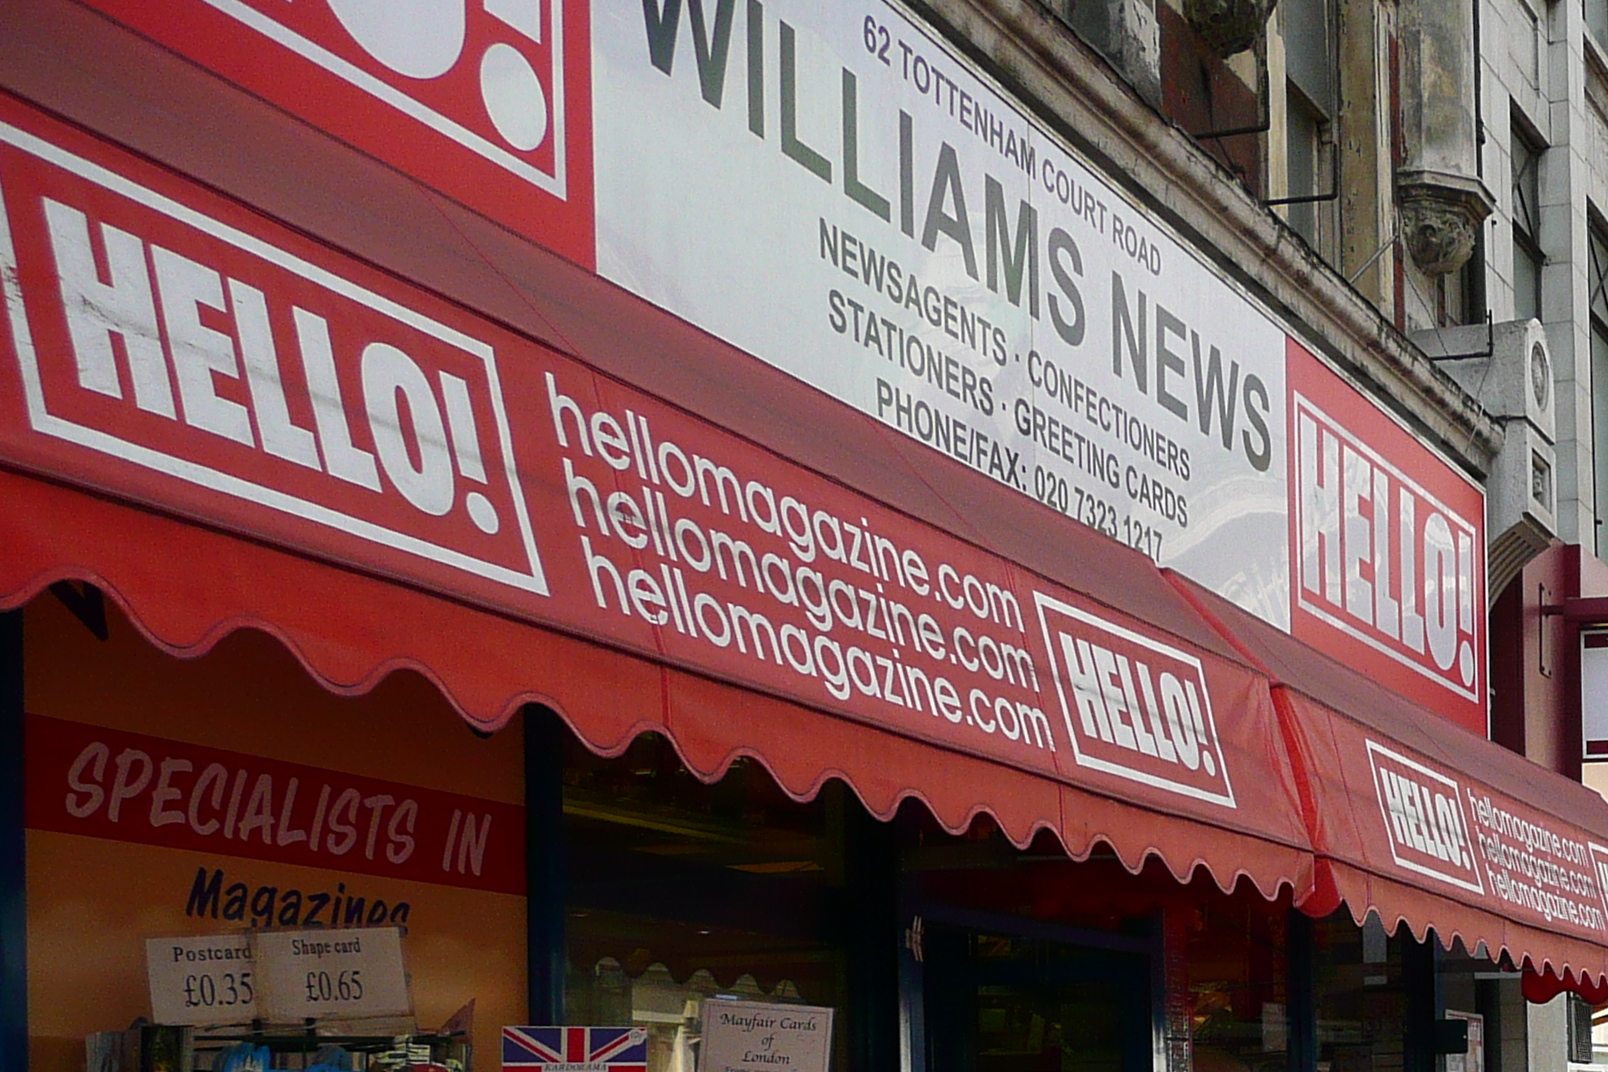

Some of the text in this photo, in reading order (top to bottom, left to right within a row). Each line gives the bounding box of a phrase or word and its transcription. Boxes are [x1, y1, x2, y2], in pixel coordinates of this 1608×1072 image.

[864, 15, 1162, 276] 62 TOTTENHAM COURT ROAD
[643, 0, 1087, 347] WILLIAMS
[1111, 270, 1273, 473] NEWS
[42, 196, 499, 534] HELLO!
[819, 217, 1191, 482] NEWSAGENTS CONFECTIONERS
[828, 289, 1189, 528] STATIONERS GREETING CARDS
[545, 371, 1026, 633] hellomagazine.com
[876, 377, 1163, 563] PHONE/FAX: 020 7323 1217
[563, 459, 1039, 692] hellomagazine.com
[1300, 411, 1475, 687] HELLO!
[580, 535, 1055, 753] hellomagazine.com
[1059, 632, 1216, 777] HELLO!
[65, 741, 492, 876] SPECIALISTS IN
[1379, 767, 1471, 870] HELLO!
[1467, 787, 1590, 868] hellomagazine.com
[1476, 825, 1597, 900] hellomagazine.com
[173, 944, 253, 962] Postcard
[292, 937, 361, 957] Shape card
[1485, 863, 1606, 931] hellomagazine.com
[183, 971, 254, 1008] £0.35
[305, 970, 363, 1003] £0.65
[720, 1013, 817, 1032] Mayfair Cards
[741, 1050, 790, 1064] London
